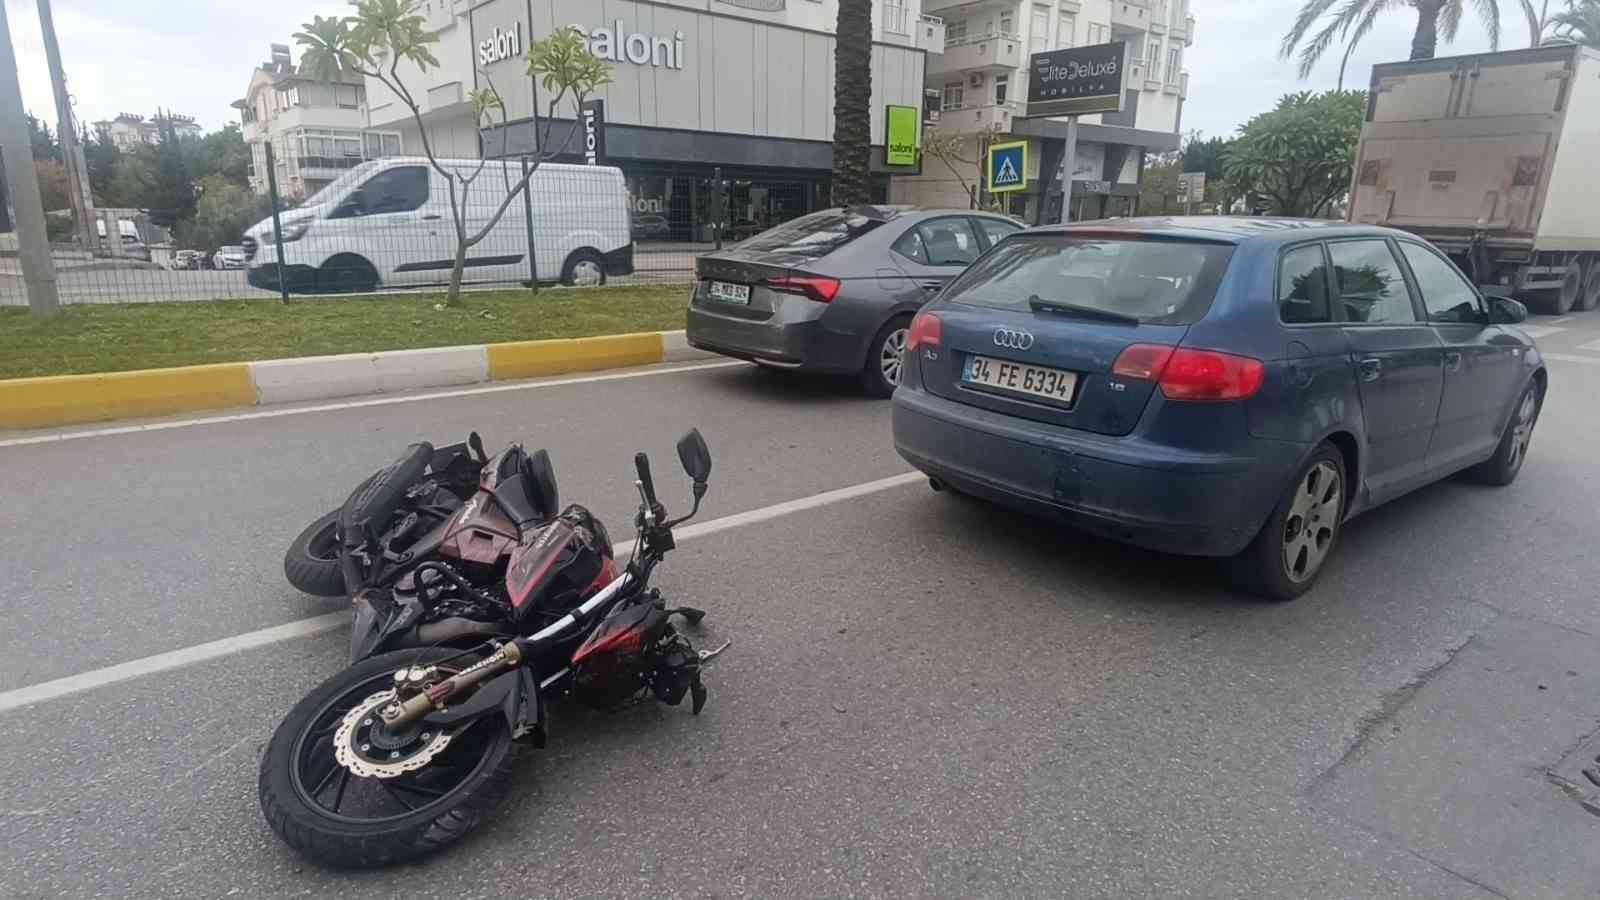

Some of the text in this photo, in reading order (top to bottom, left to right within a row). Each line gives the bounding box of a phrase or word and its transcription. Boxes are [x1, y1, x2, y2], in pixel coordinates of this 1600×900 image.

[480, 21, 519, 64] saloni
[583, 110, 596, 166] loni
[972, 359, 1066, 398] 34 FE 6334
